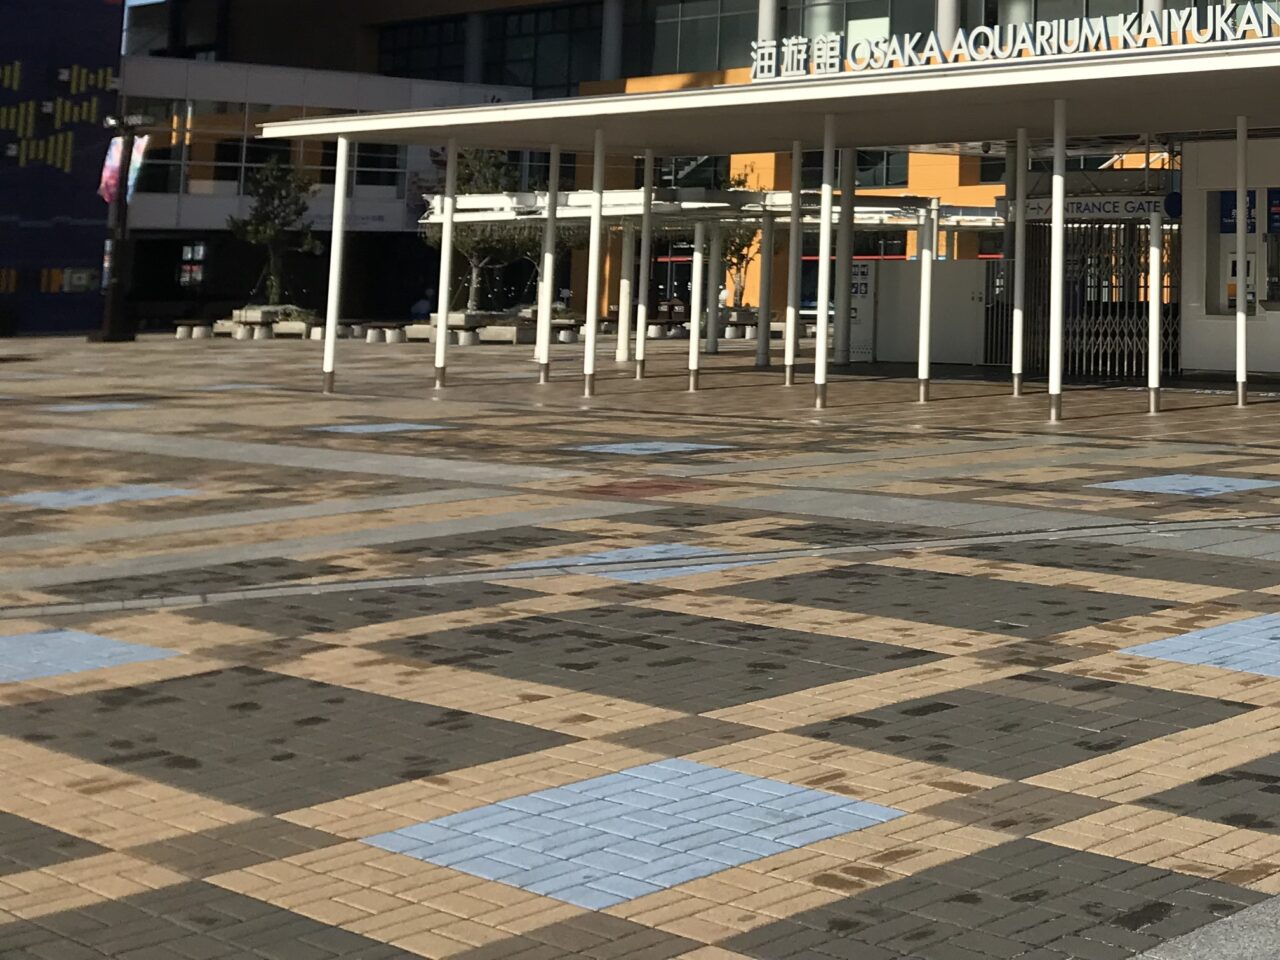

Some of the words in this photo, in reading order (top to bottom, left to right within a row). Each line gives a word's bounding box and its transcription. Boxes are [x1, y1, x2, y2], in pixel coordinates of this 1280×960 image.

[750, 31, 842, 79] 海遊館
[848, 30, 944, 71] OSAKA
[948, 16, 1109, 62] AQUARIUM
[1055, 201, 1120, 214] NTRANCE
[1124, 200, 1161, 213] GATE
